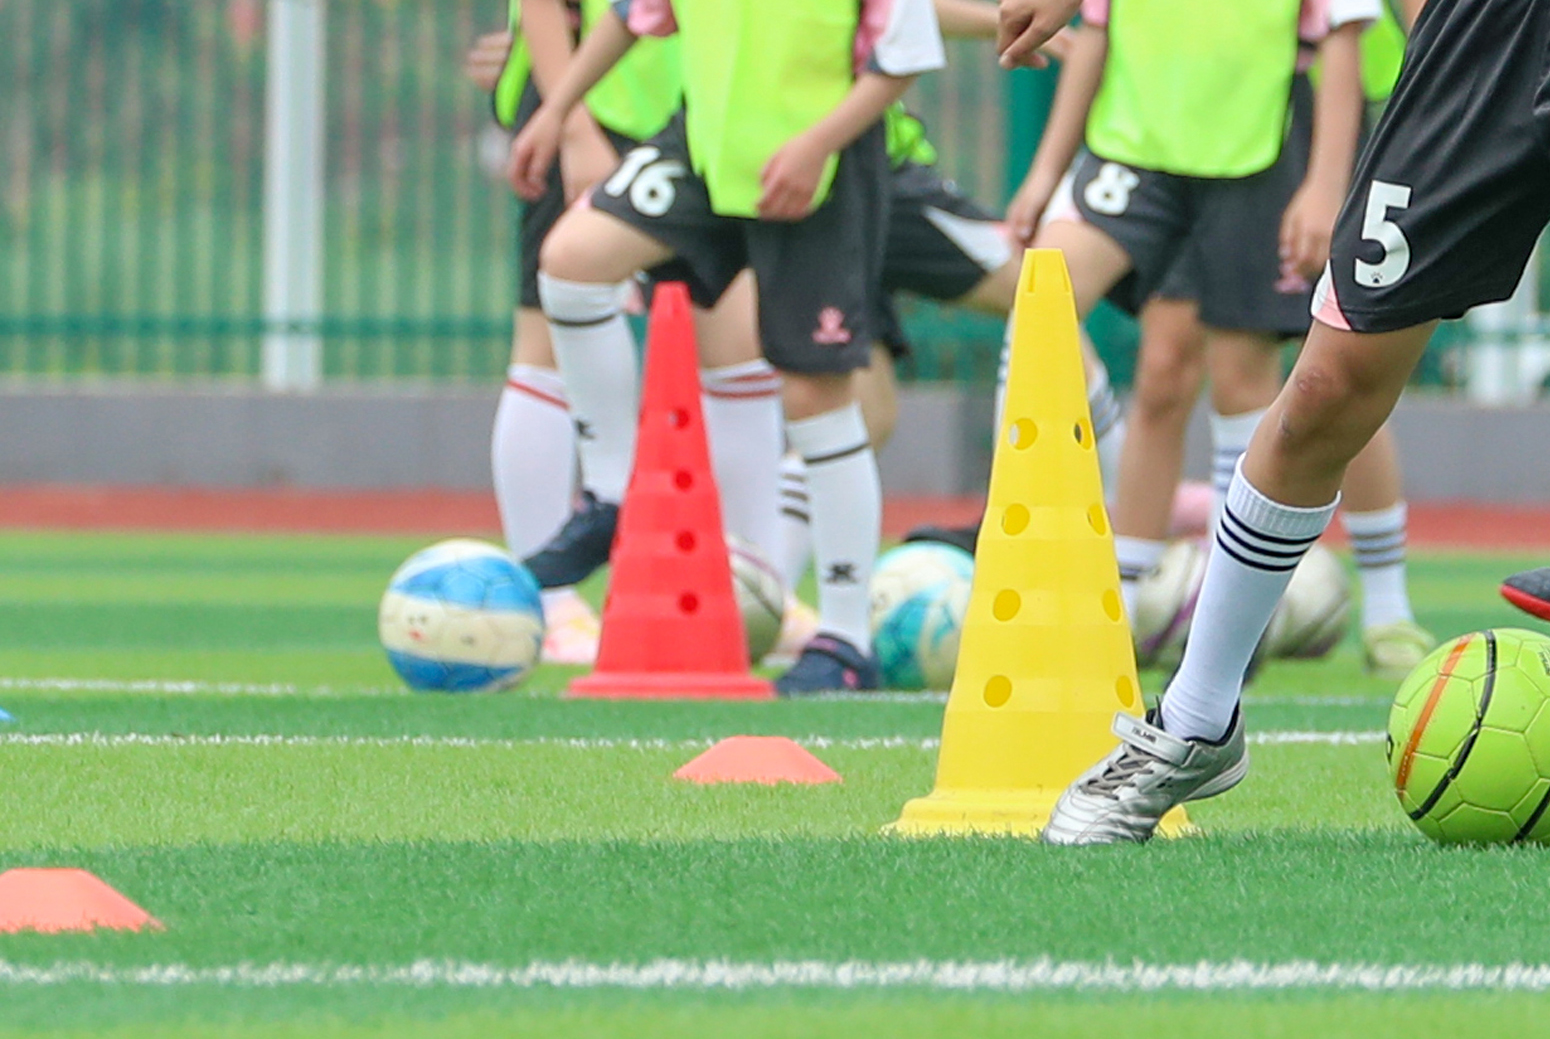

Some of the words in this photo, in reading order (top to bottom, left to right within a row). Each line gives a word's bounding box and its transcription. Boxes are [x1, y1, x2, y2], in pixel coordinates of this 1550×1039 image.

[604, 145, 686, 217] 16
[1084, 162, 1140, 215] 8
[1354, 179, 1412, 288] 5
